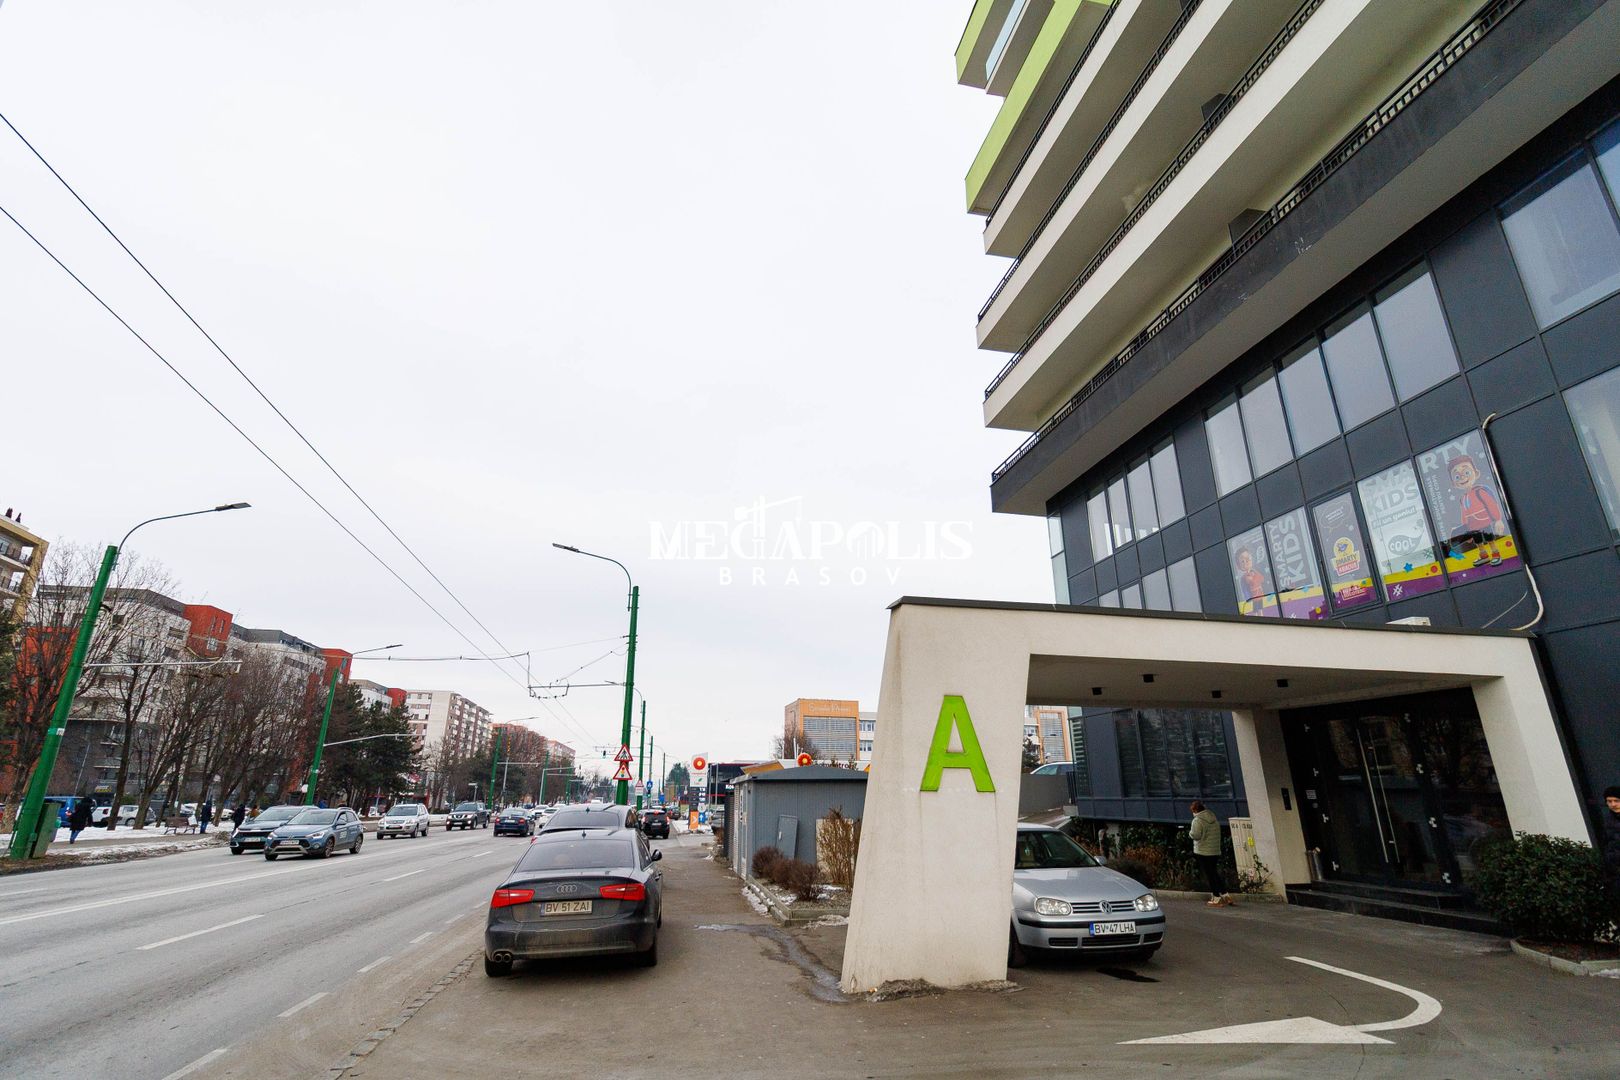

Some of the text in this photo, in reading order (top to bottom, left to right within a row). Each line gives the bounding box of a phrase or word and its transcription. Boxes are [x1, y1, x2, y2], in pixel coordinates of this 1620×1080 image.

[1369, 481, 1418, 513] KIDS
[1270, 524, 1291, 587] SMARTY
[1280, 515, 1306, 584] KIDS
[920, 694, 996, 793] A
[546, 901, 590, 913] BV 51 ZAI
[1094, 922, 1135, 934] BV 47 LHA
